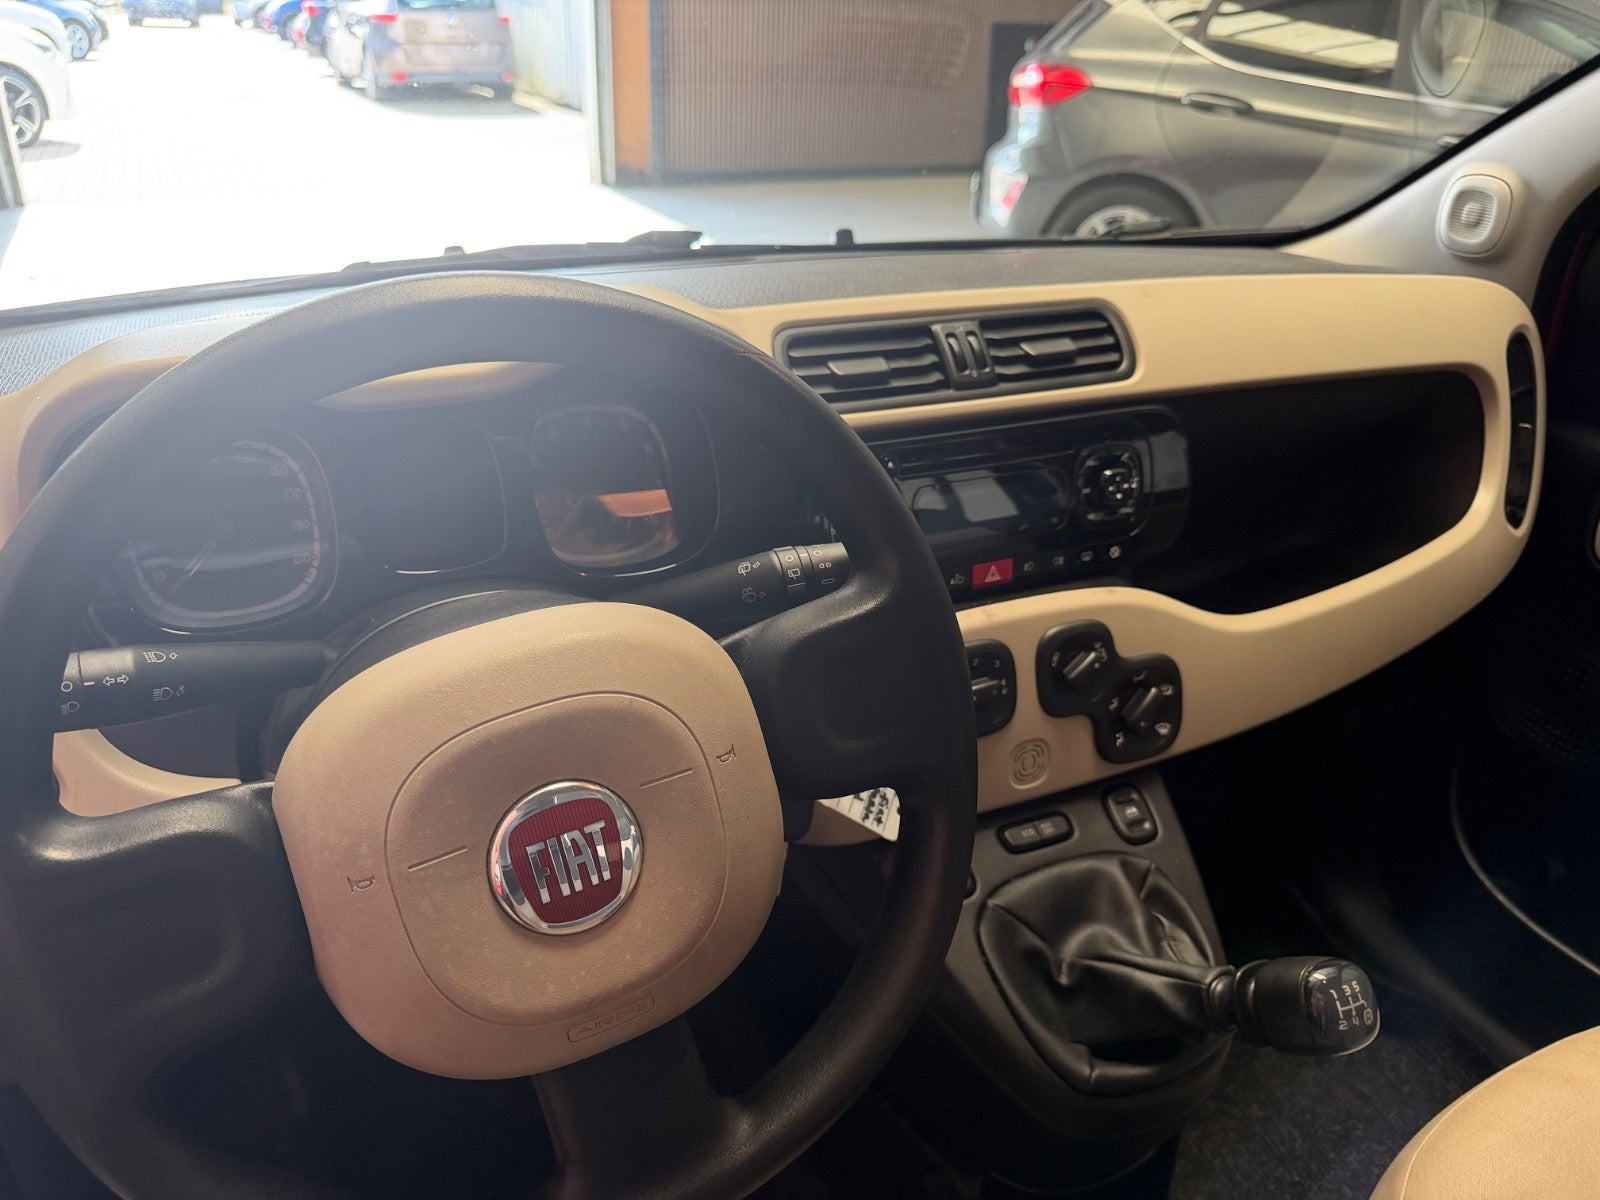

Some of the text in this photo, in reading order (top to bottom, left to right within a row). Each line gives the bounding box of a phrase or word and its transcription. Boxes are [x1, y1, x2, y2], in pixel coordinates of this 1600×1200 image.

[525, 819, 612, 905] FIAT
[1341, 984, 1352, 996] 3
[1351, 980, 1360, 992] 5
[1329, 989, 1338, 1000] 1
[1338, 1020, 1349, 1031] 2
[1352, 1016, 1360, 1027] 4
